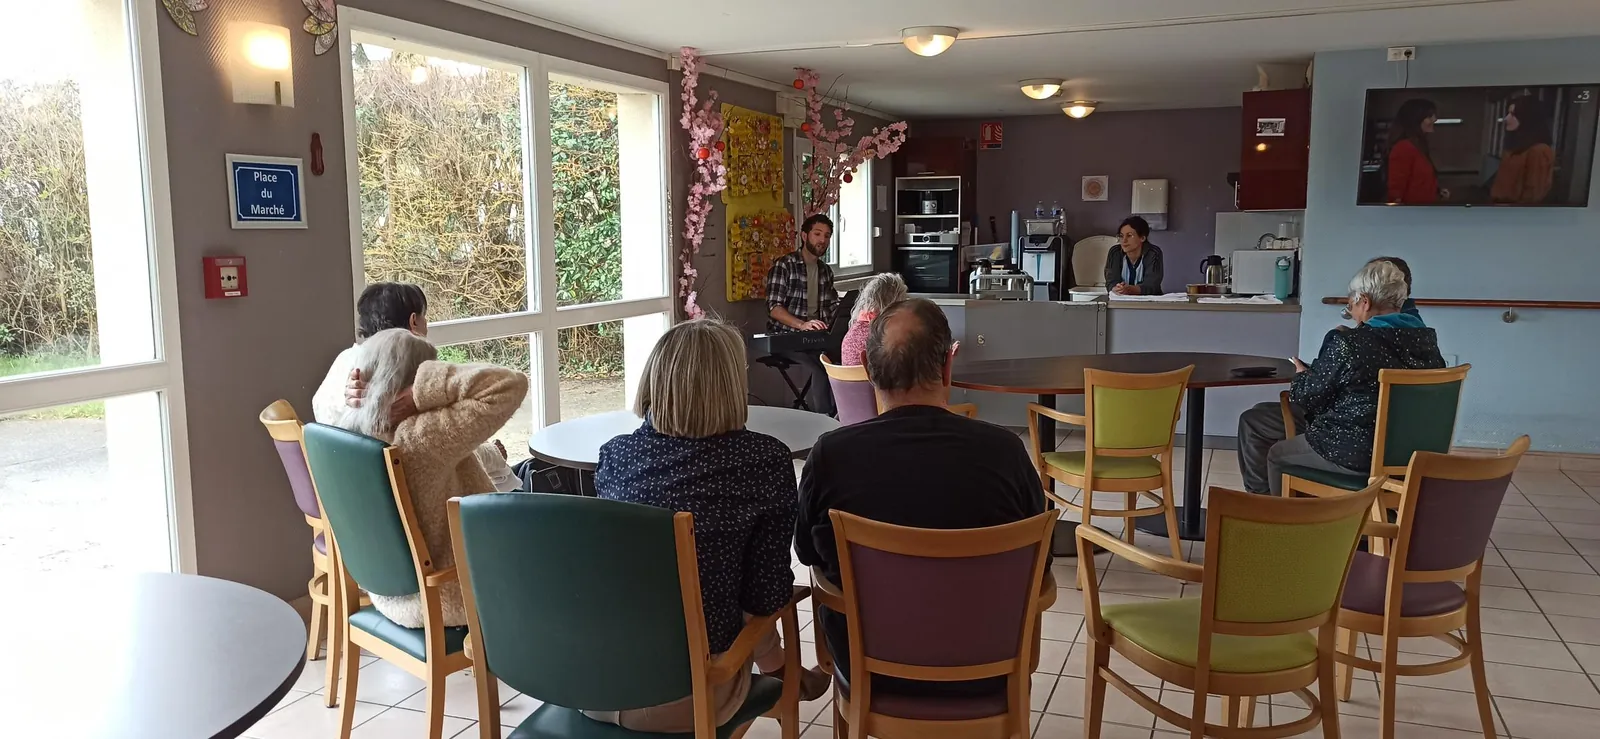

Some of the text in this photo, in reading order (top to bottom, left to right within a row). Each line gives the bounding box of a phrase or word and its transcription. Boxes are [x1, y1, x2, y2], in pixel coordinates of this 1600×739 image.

[1582, 90, 1590, 100] 3
[254, 171, 278, 183] Place
[261, 188, 273, 199] du
[251, 204, 285, 215] Marché
